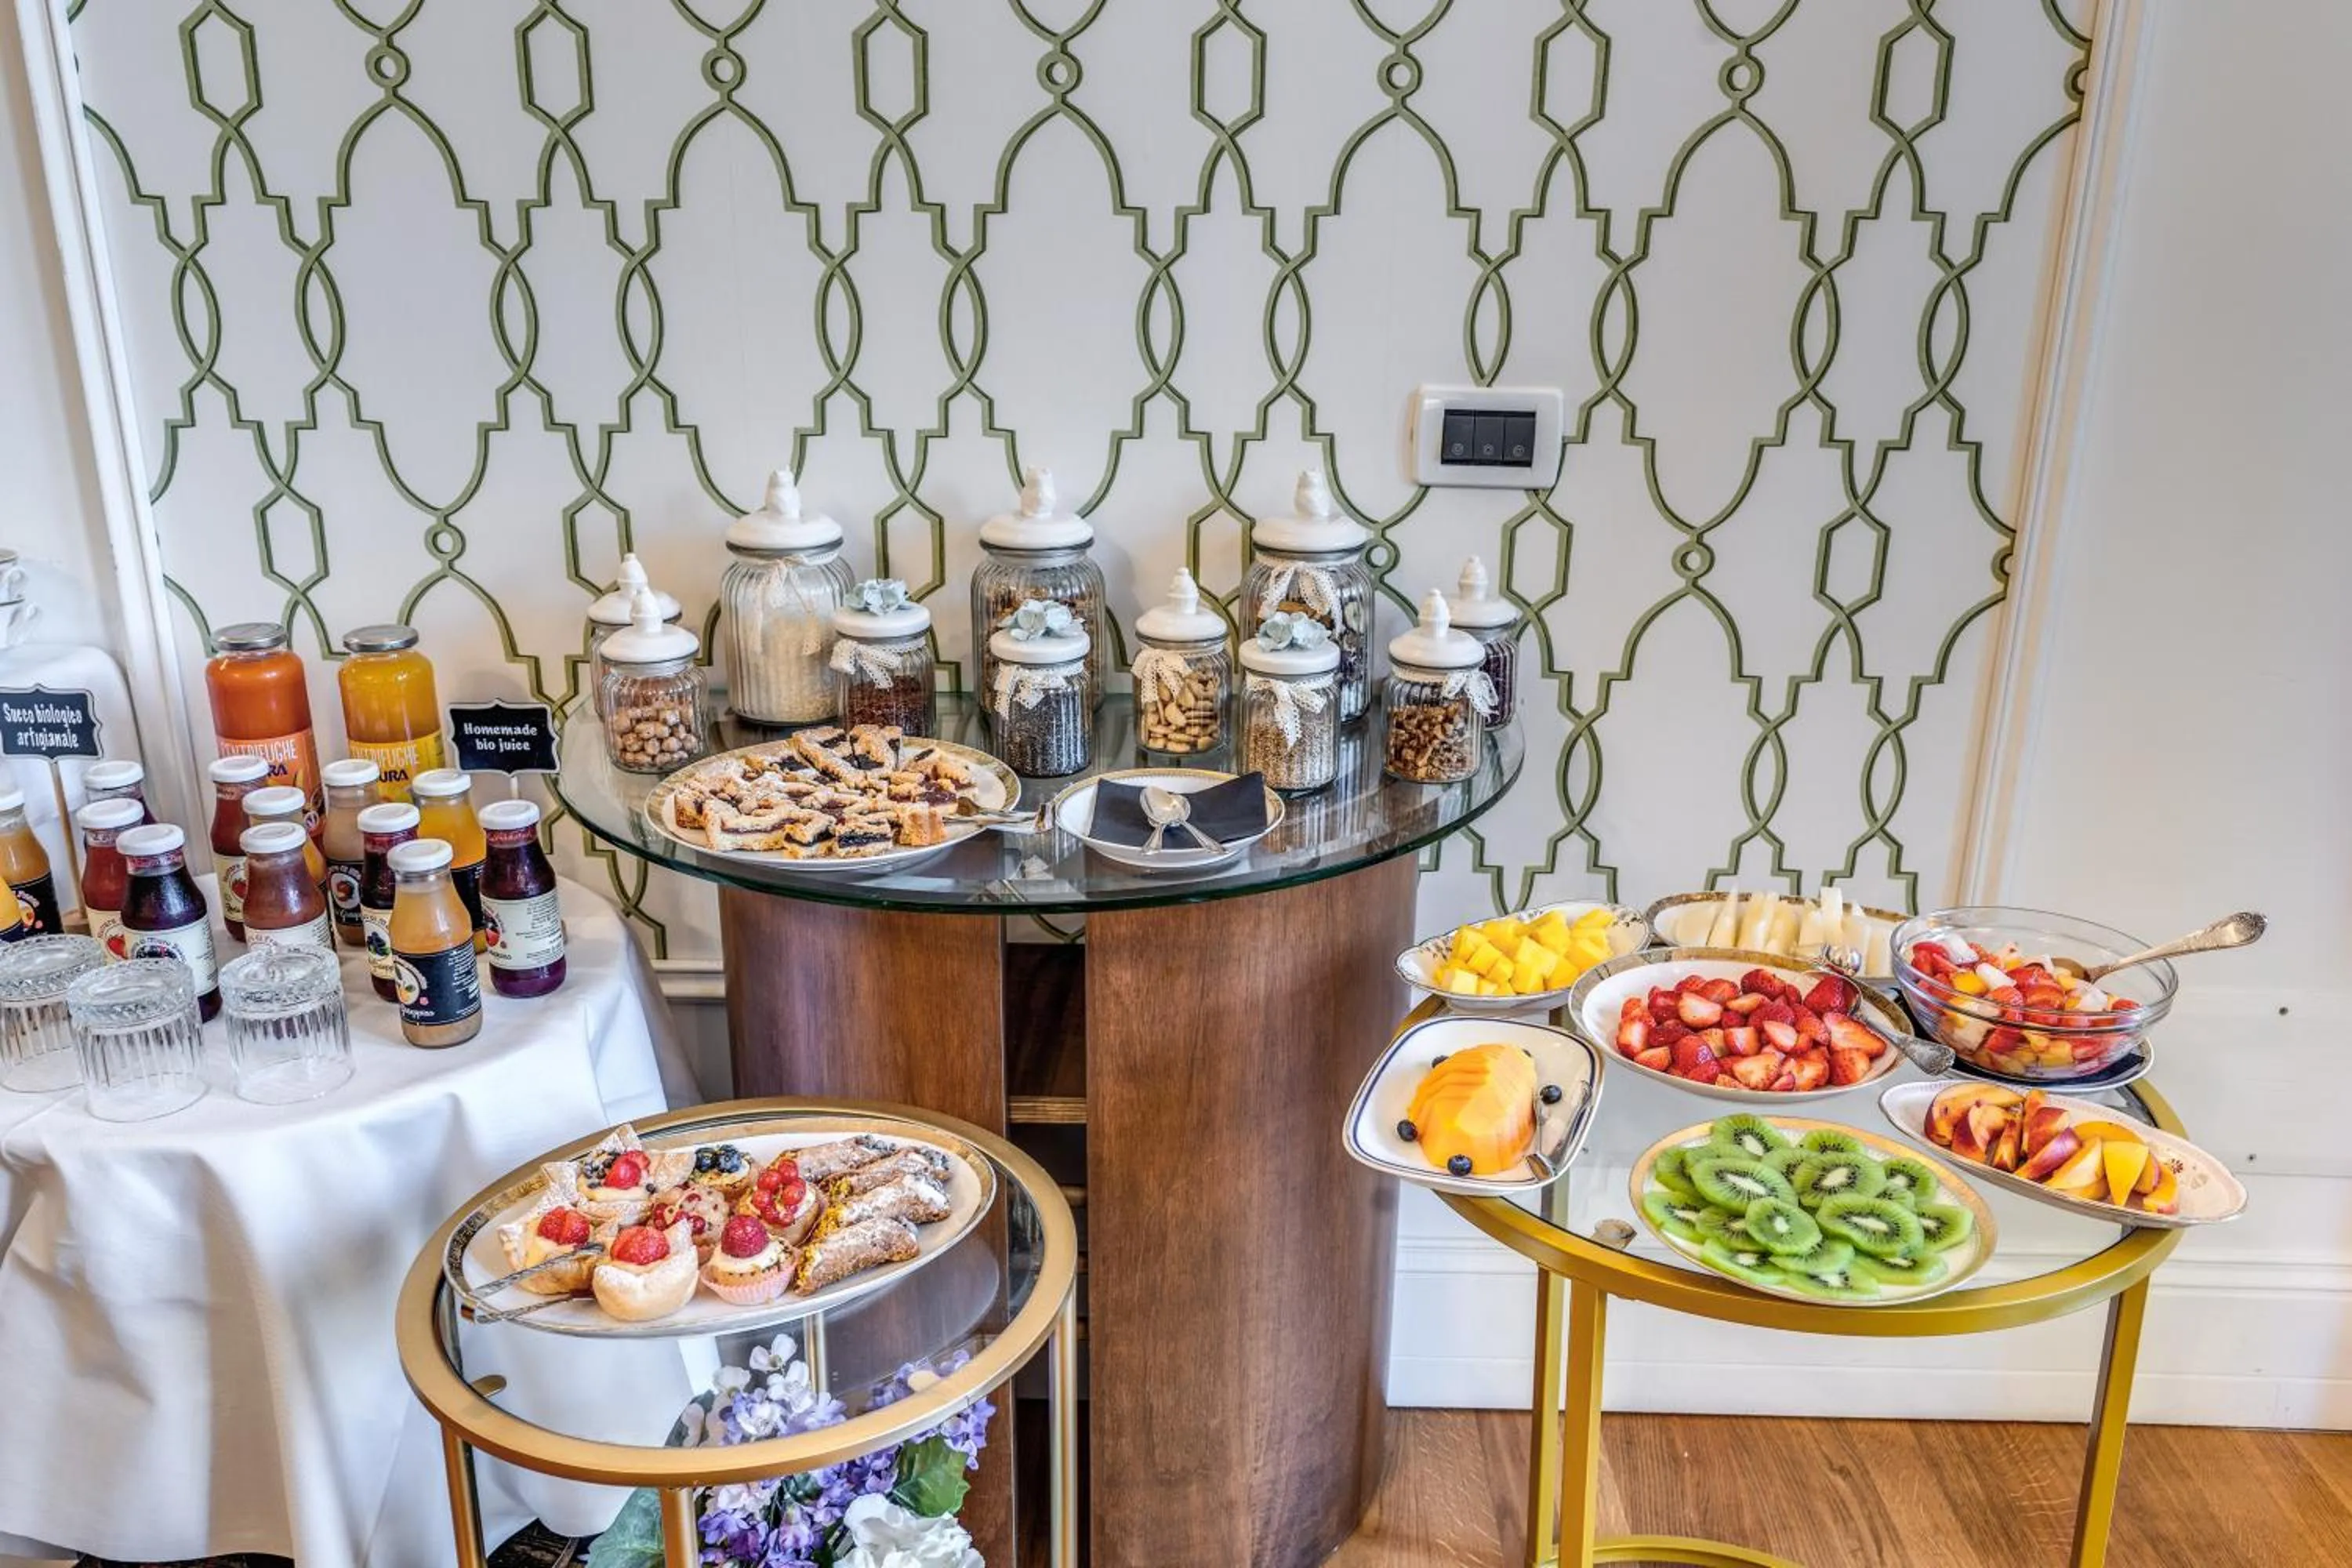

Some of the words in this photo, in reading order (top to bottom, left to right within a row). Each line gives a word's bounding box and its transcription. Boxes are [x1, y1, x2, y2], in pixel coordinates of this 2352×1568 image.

[3, 702, 35, 724] Succo
[34, 703, 82, 728] biologico
[463, 722, 538, 736] Homemade
[17, 727, 79, 750] artigianale
[475, 739, 495, 750] bio
[499, 739, 531, 753] juice
[378, 769, 408, 782] URA
